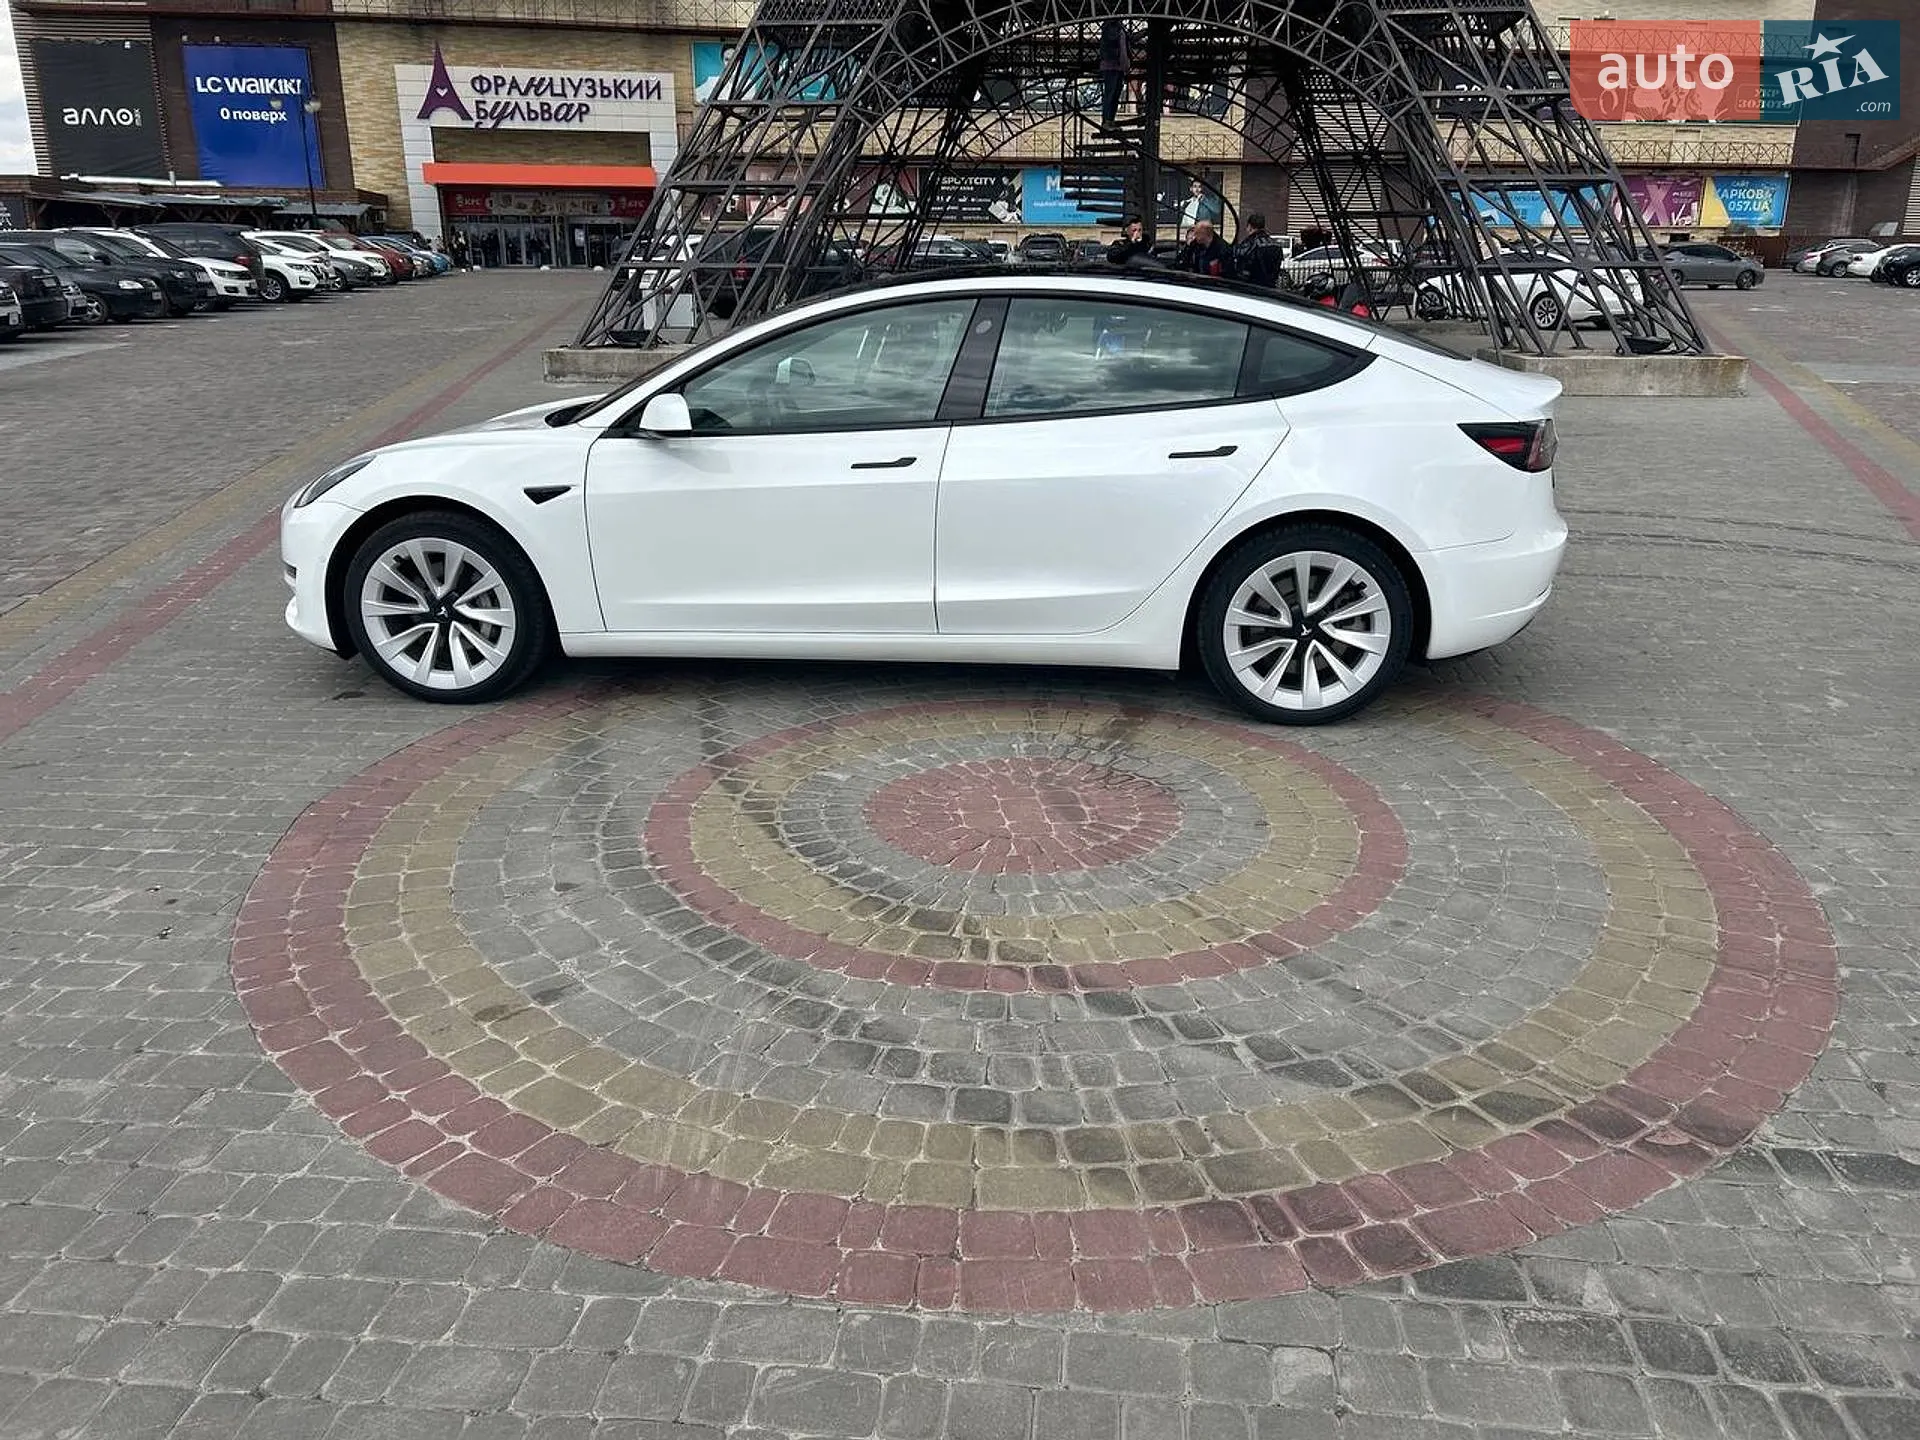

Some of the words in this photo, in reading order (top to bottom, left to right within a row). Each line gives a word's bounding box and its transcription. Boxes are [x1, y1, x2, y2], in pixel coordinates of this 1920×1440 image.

[195, 76, 223, 93] LC
[470, 74, 662, 100] ФРАНЦУЗЬКИЙ
[220, 107, 231, 120] 0
[233, 110, 287, 124] поверх
[1728, 200, 1771, 212] 057.UA
